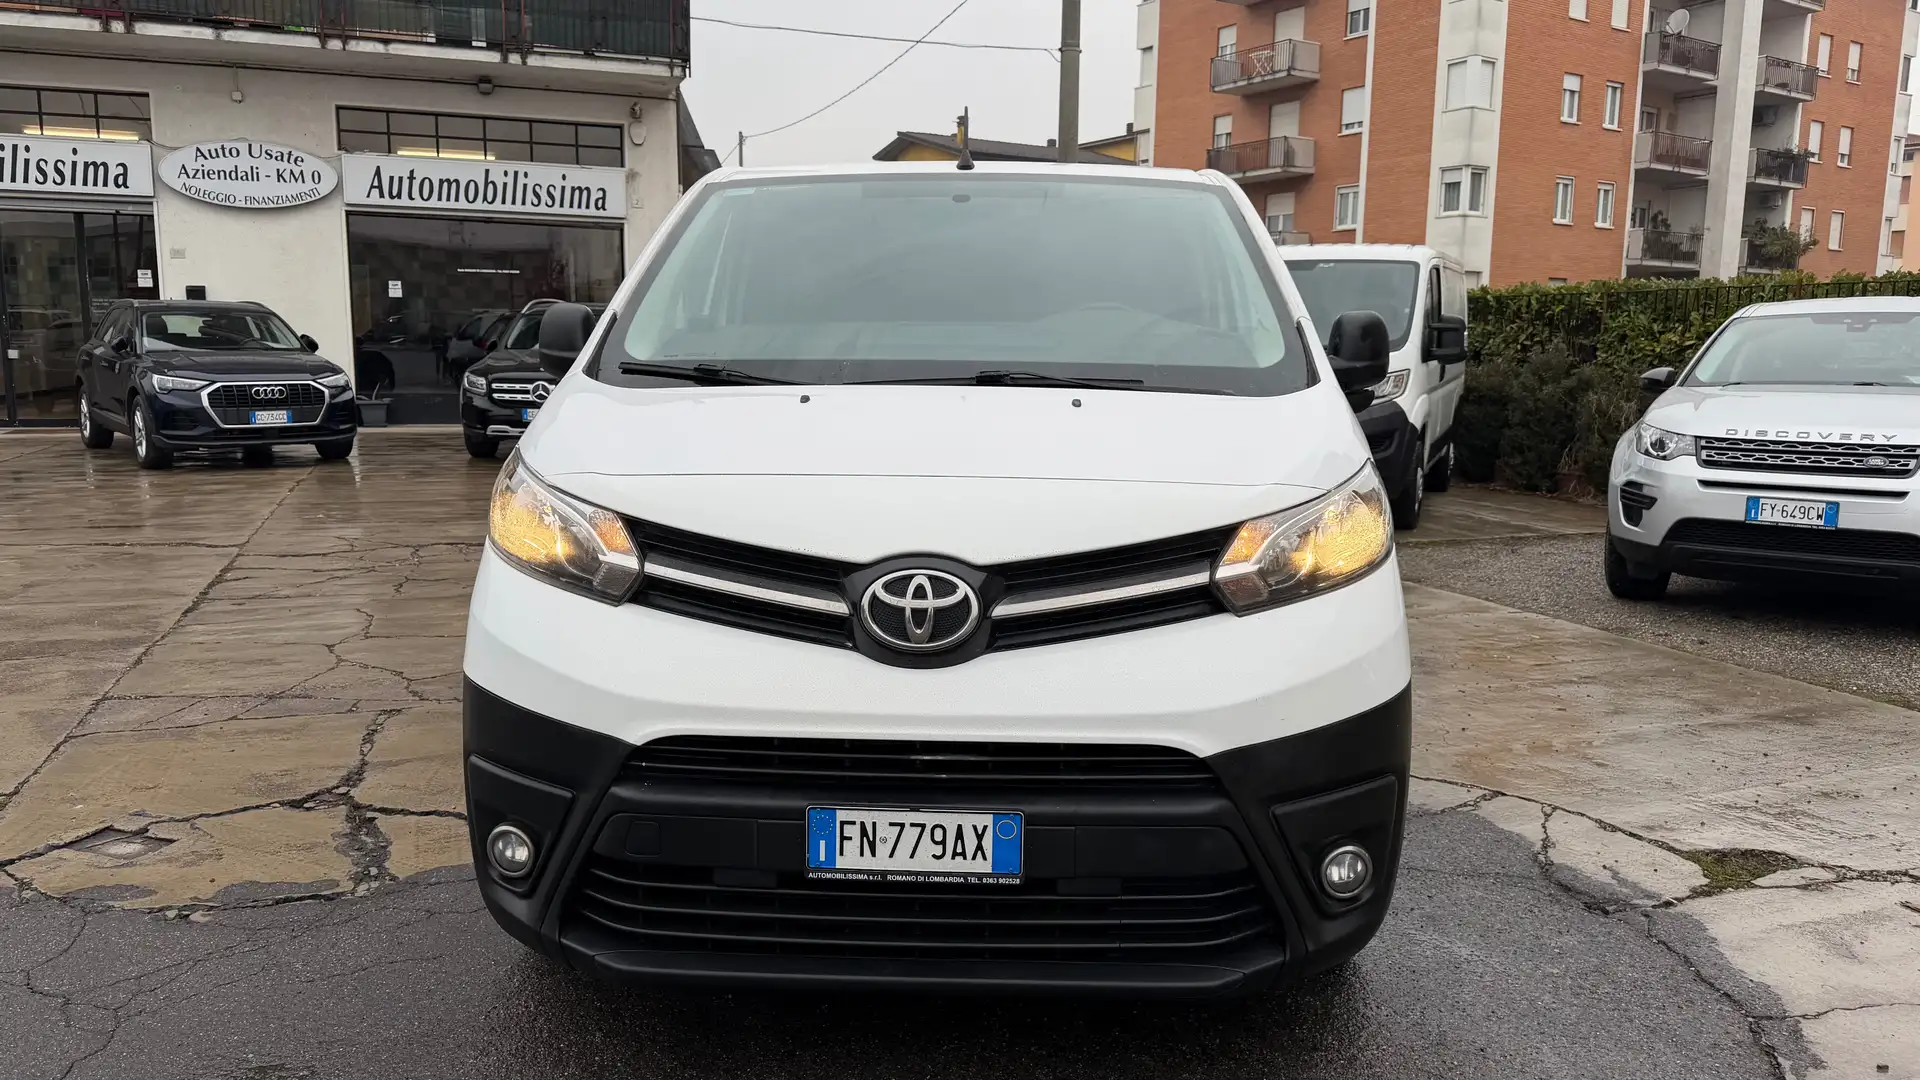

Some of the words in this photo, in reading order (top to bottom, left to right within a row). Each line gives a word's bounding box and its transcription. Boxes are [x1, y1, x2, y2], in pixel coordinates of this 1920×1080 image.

[194, 144, 240, 162] Auto
[248, 143, 304, 167] Usate
[177, 163, 260, 182] Aziendali
[276, 168, 306, 184] KM
[180, 182, 236, 204] NOLEGGIO
[244, 187, 321, 206] FINANZIAMENTI
[366, 165, 608, 211] Automobilissima
[1725, 428, 1898, 442] DISCOVERY
[808, 872, 868, 880] AUTOMOBILISSIMA
